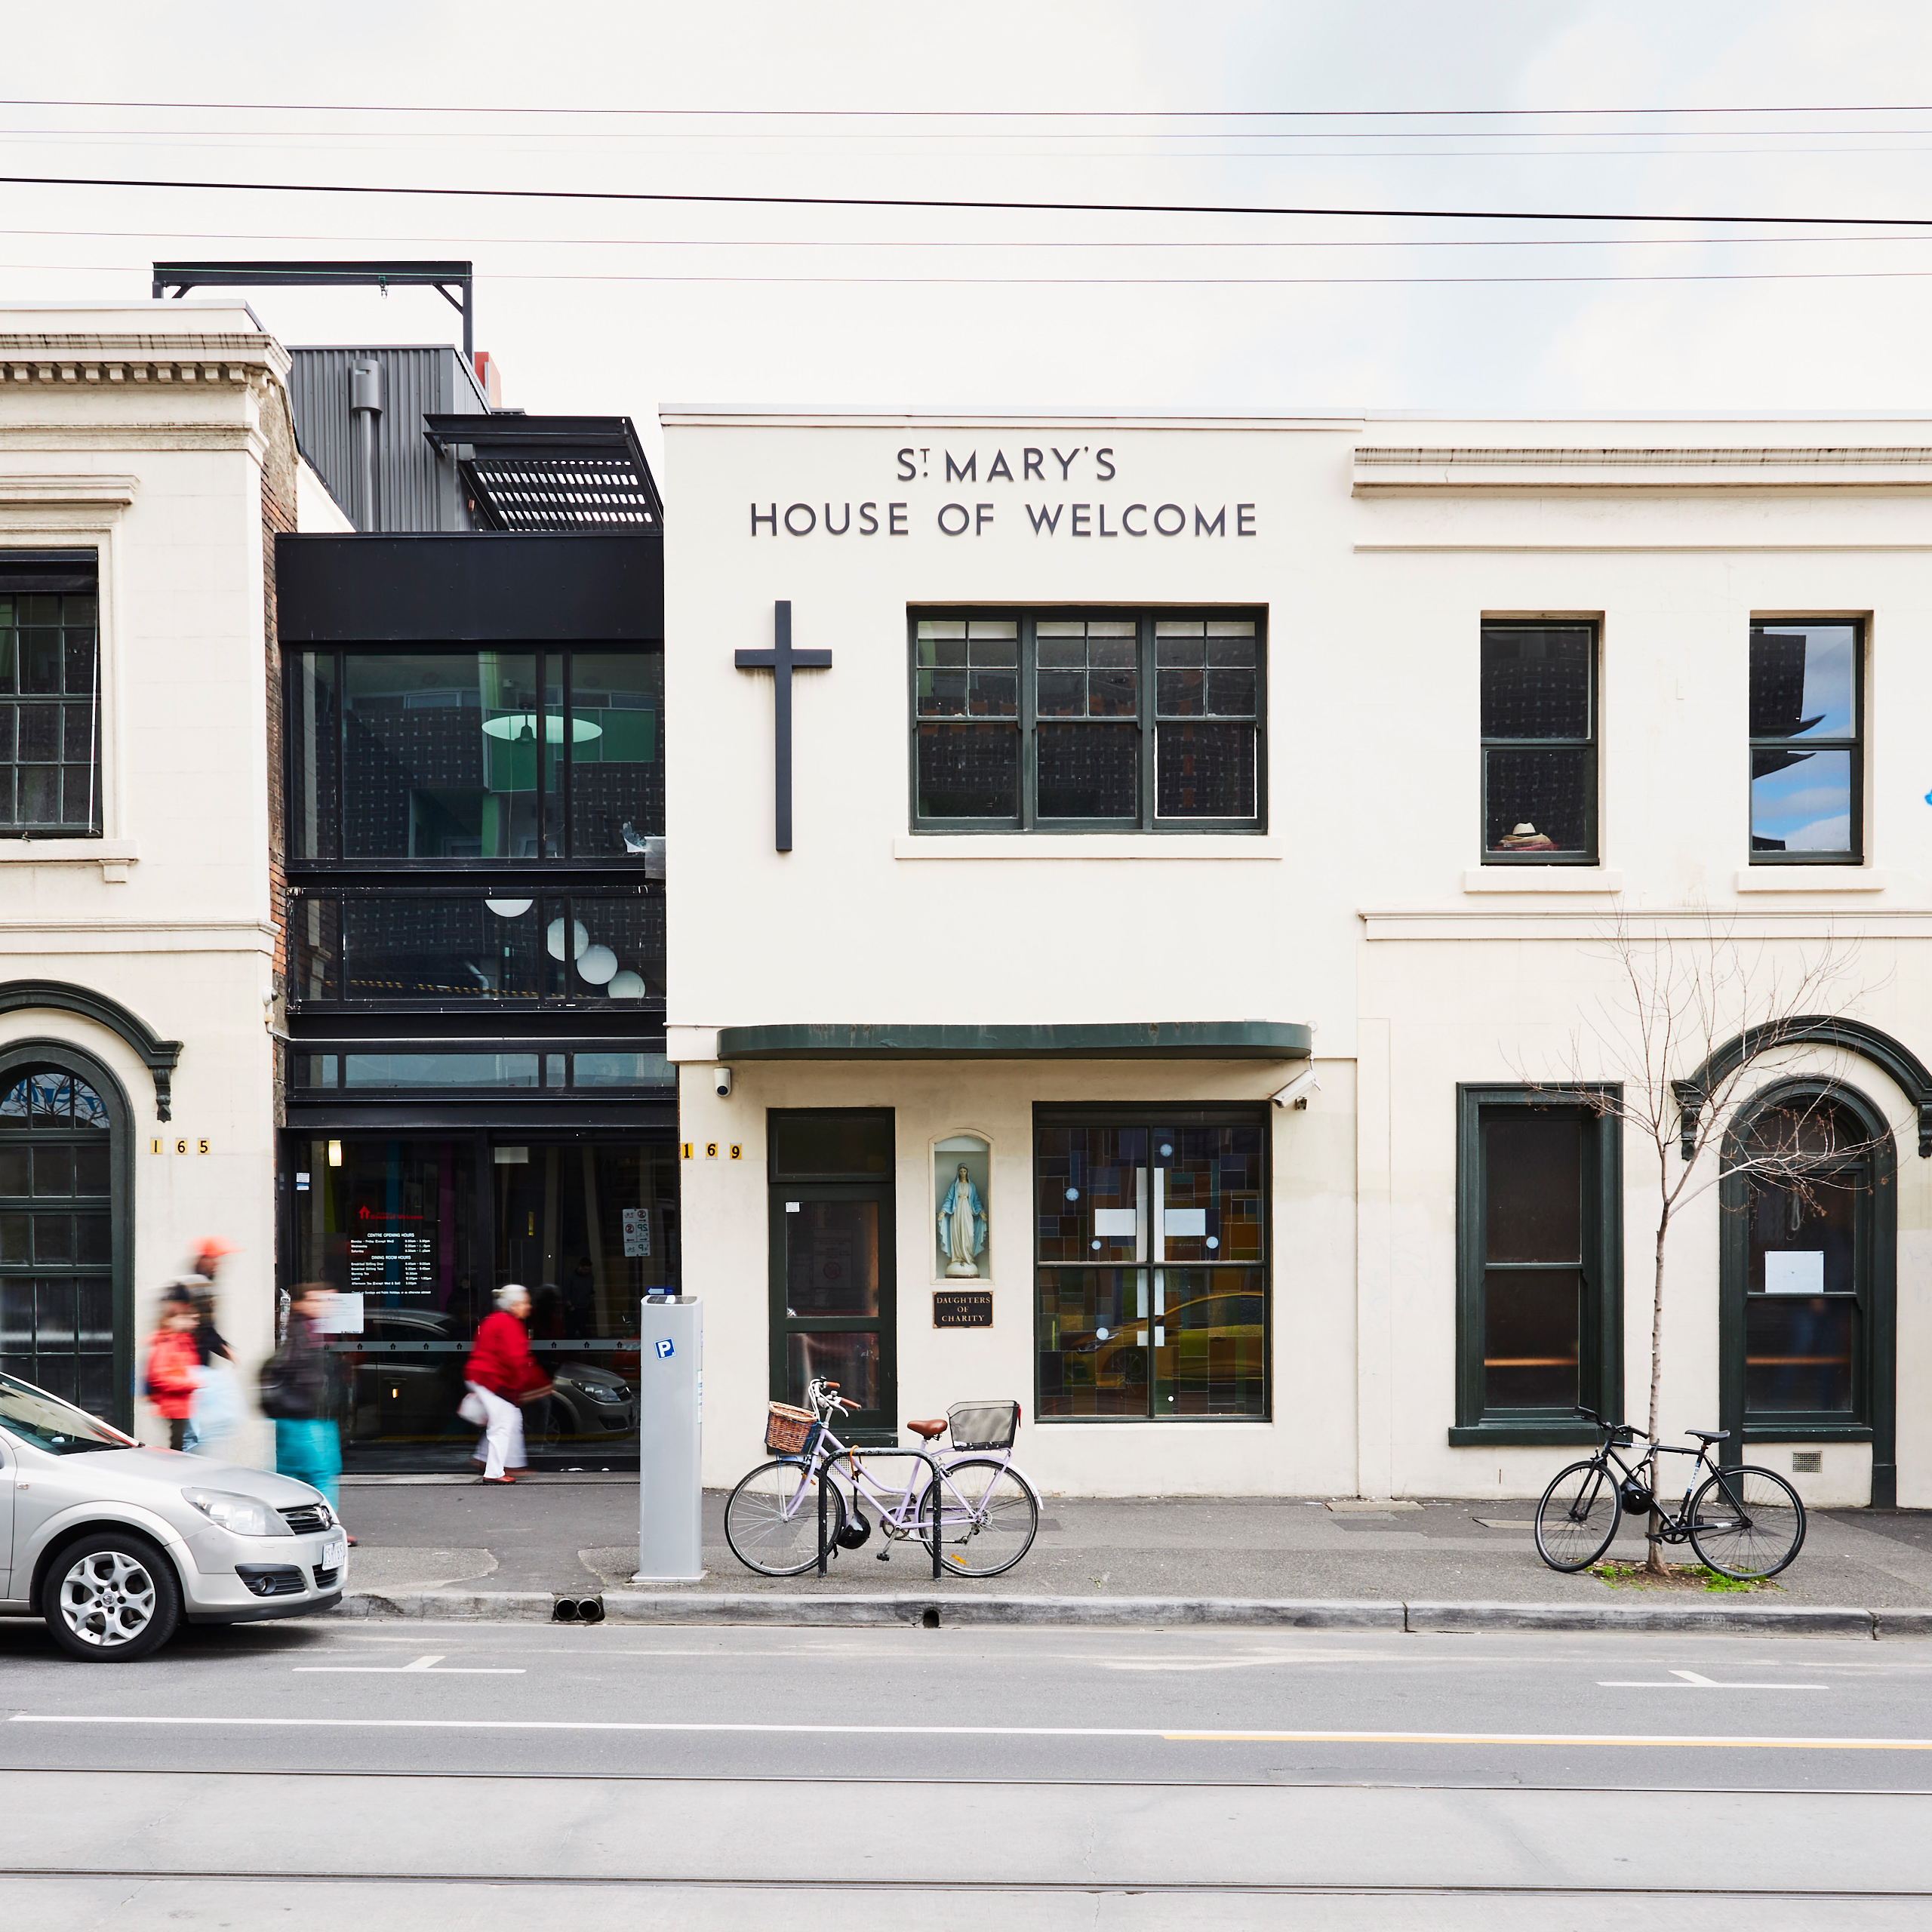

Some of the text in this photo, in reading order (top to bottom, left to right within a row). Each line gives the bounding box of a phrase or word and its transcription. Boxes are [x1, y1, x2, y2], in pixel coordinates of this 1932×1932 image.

[945, 447, 1116, 482] MARY'S
[751, 502, 1257, 537] HOUSE OF WELCOME
